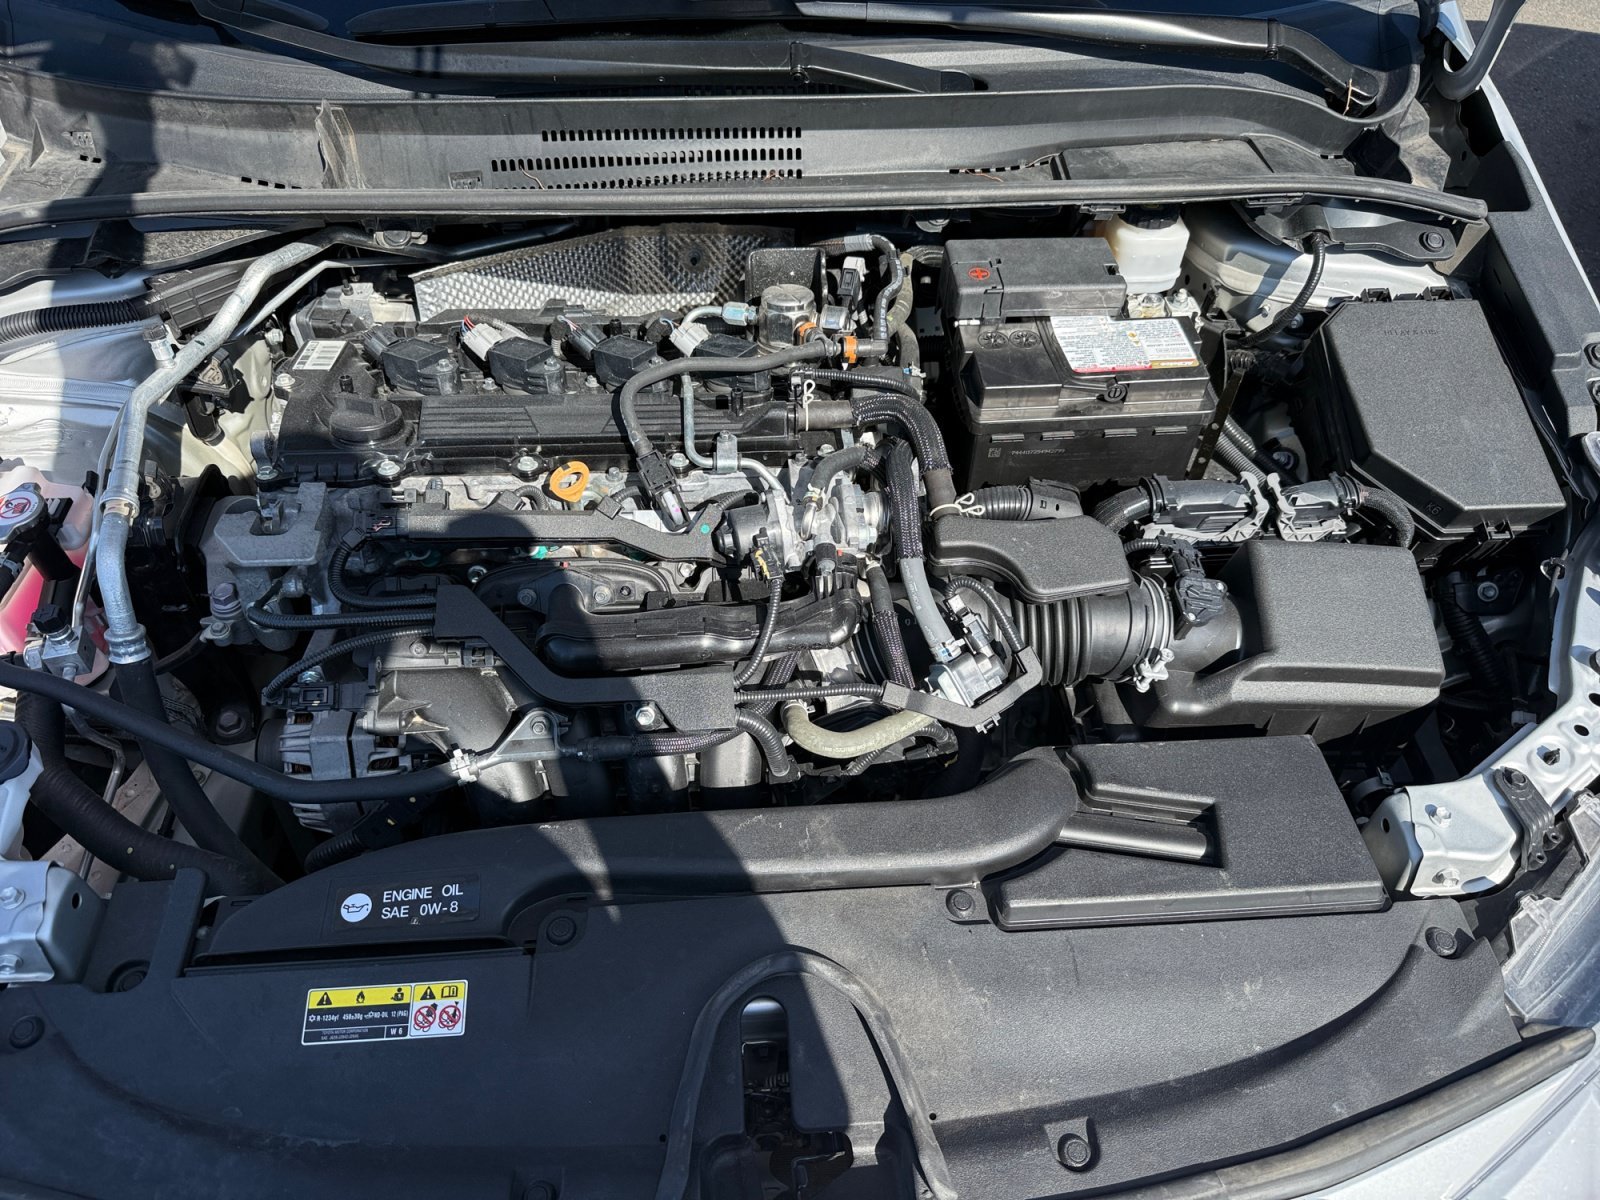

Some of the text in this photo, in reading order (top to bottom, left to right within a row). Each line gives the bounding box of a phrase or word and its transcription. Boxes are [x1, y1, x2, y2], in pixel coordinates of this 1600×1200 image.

[1424, 502, 1442, 515] K6
[383, 884, 464, 902] ENGINE OIL
[381, 901, 458, 919] SAE 0W-8
[398, 1027, 403, 1035] 6
